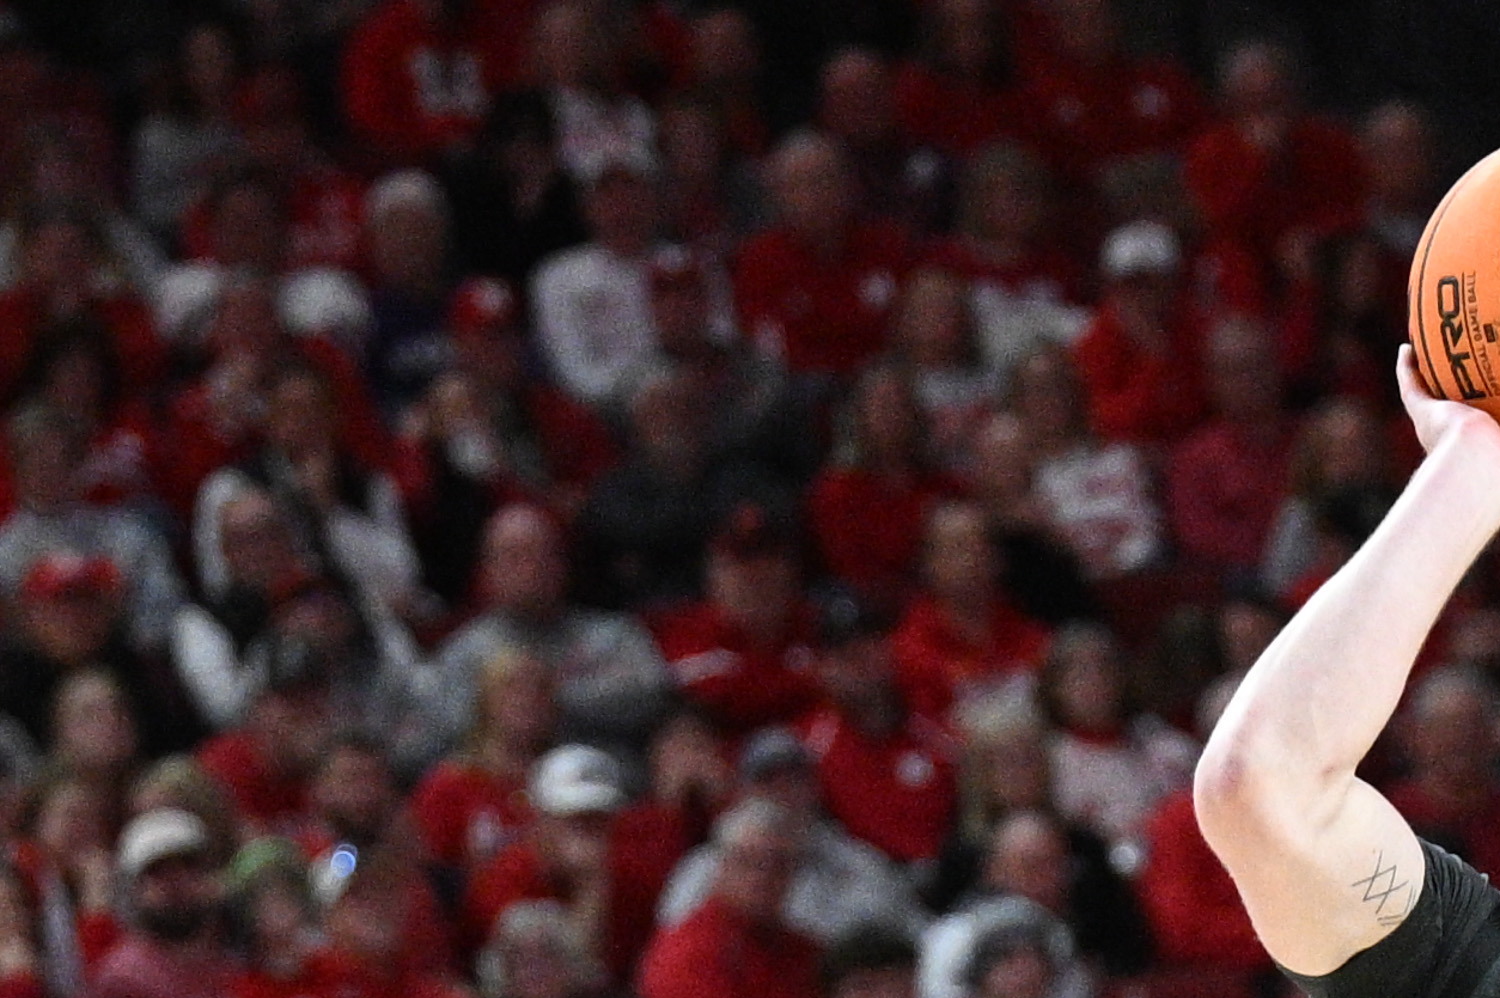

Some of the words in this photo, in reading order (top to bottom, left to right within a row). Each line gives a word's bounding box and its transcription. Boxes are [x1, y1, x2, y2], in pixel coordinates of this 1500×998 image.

[1466, 271, 1477, 304] BALL
[1437, 276, 1486, 400] PRO
[1469, 306, 1483, 342] GAME
